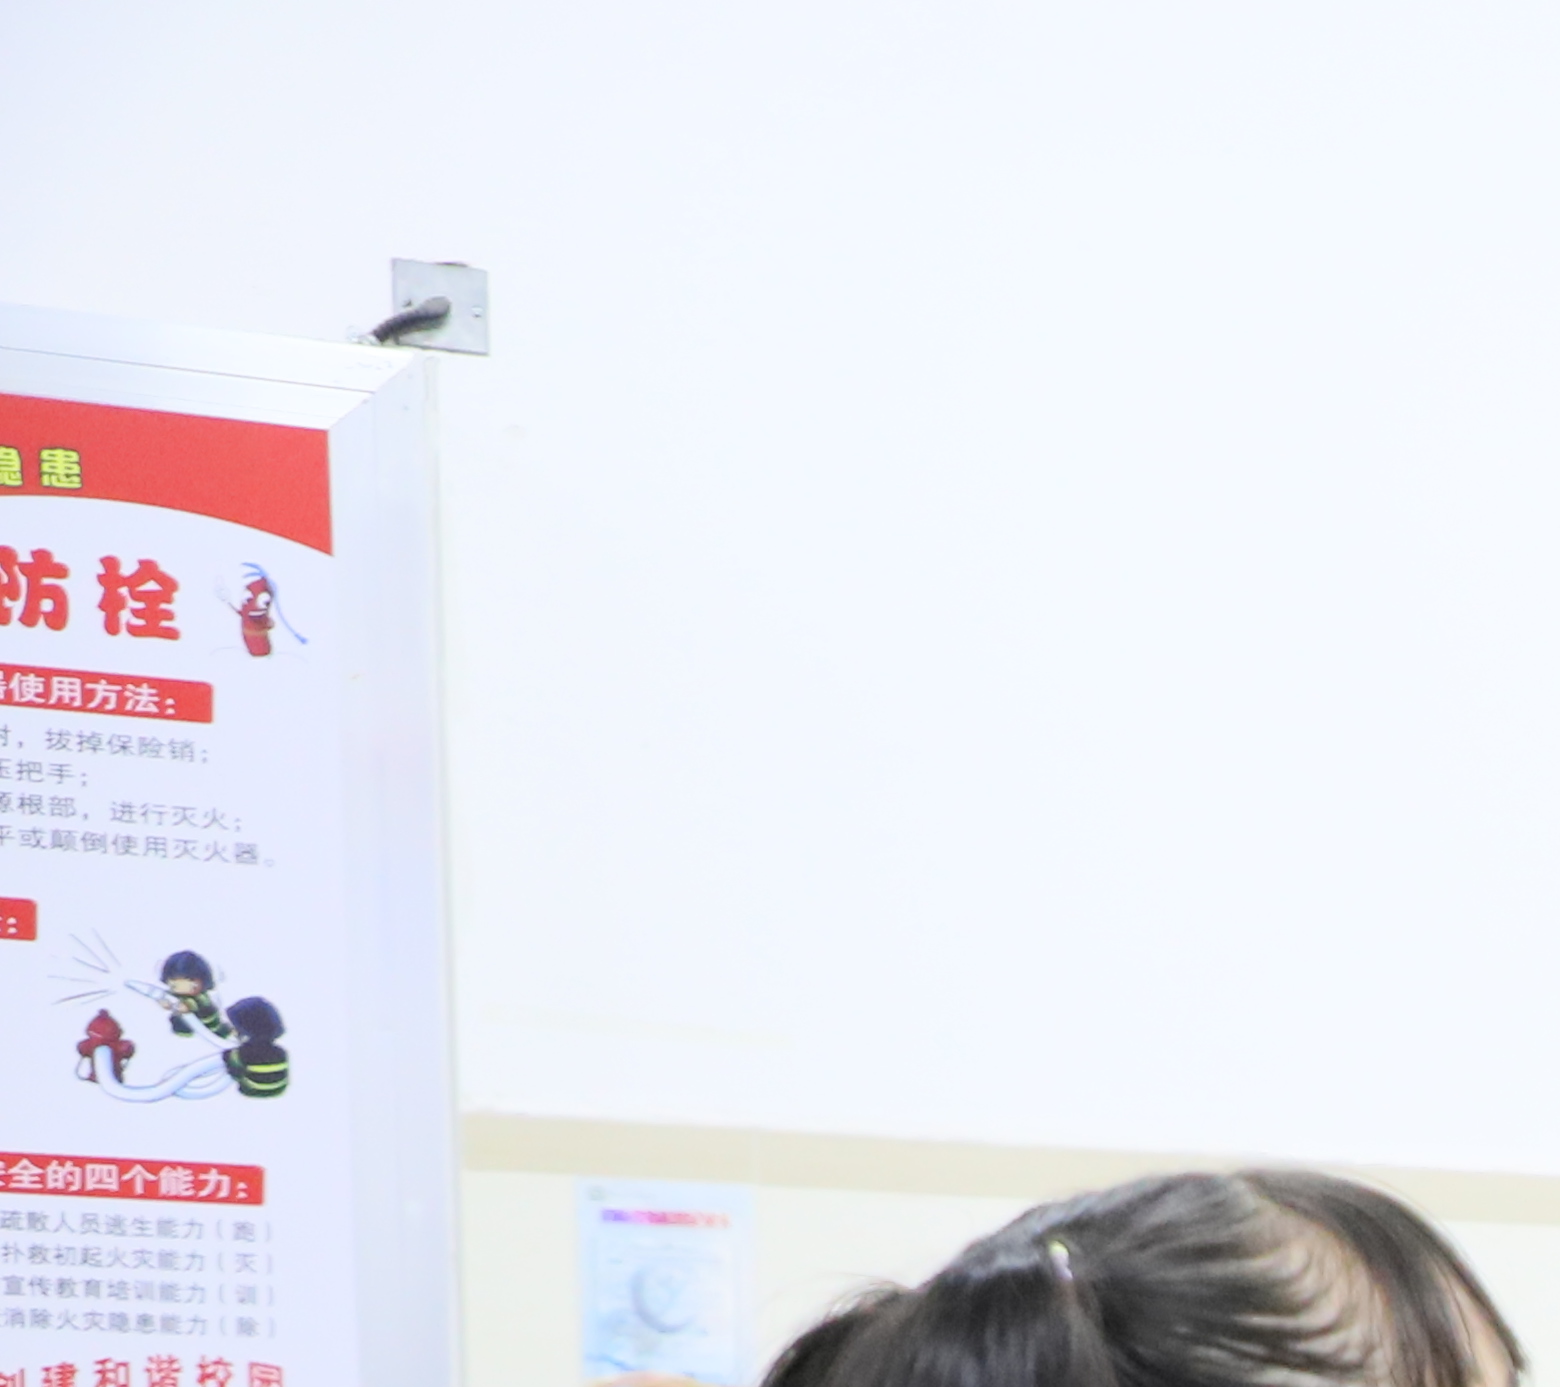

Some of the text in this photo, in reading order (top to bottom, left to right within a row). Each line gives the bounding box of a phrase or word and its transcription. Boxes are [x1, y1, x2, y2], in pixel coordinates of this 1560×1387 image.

[0, 545, 181, 640] 防栓
[0, 671, 175, 714] 使用方法：
[0, 1158, 248, 1199] 全的四个能力：
